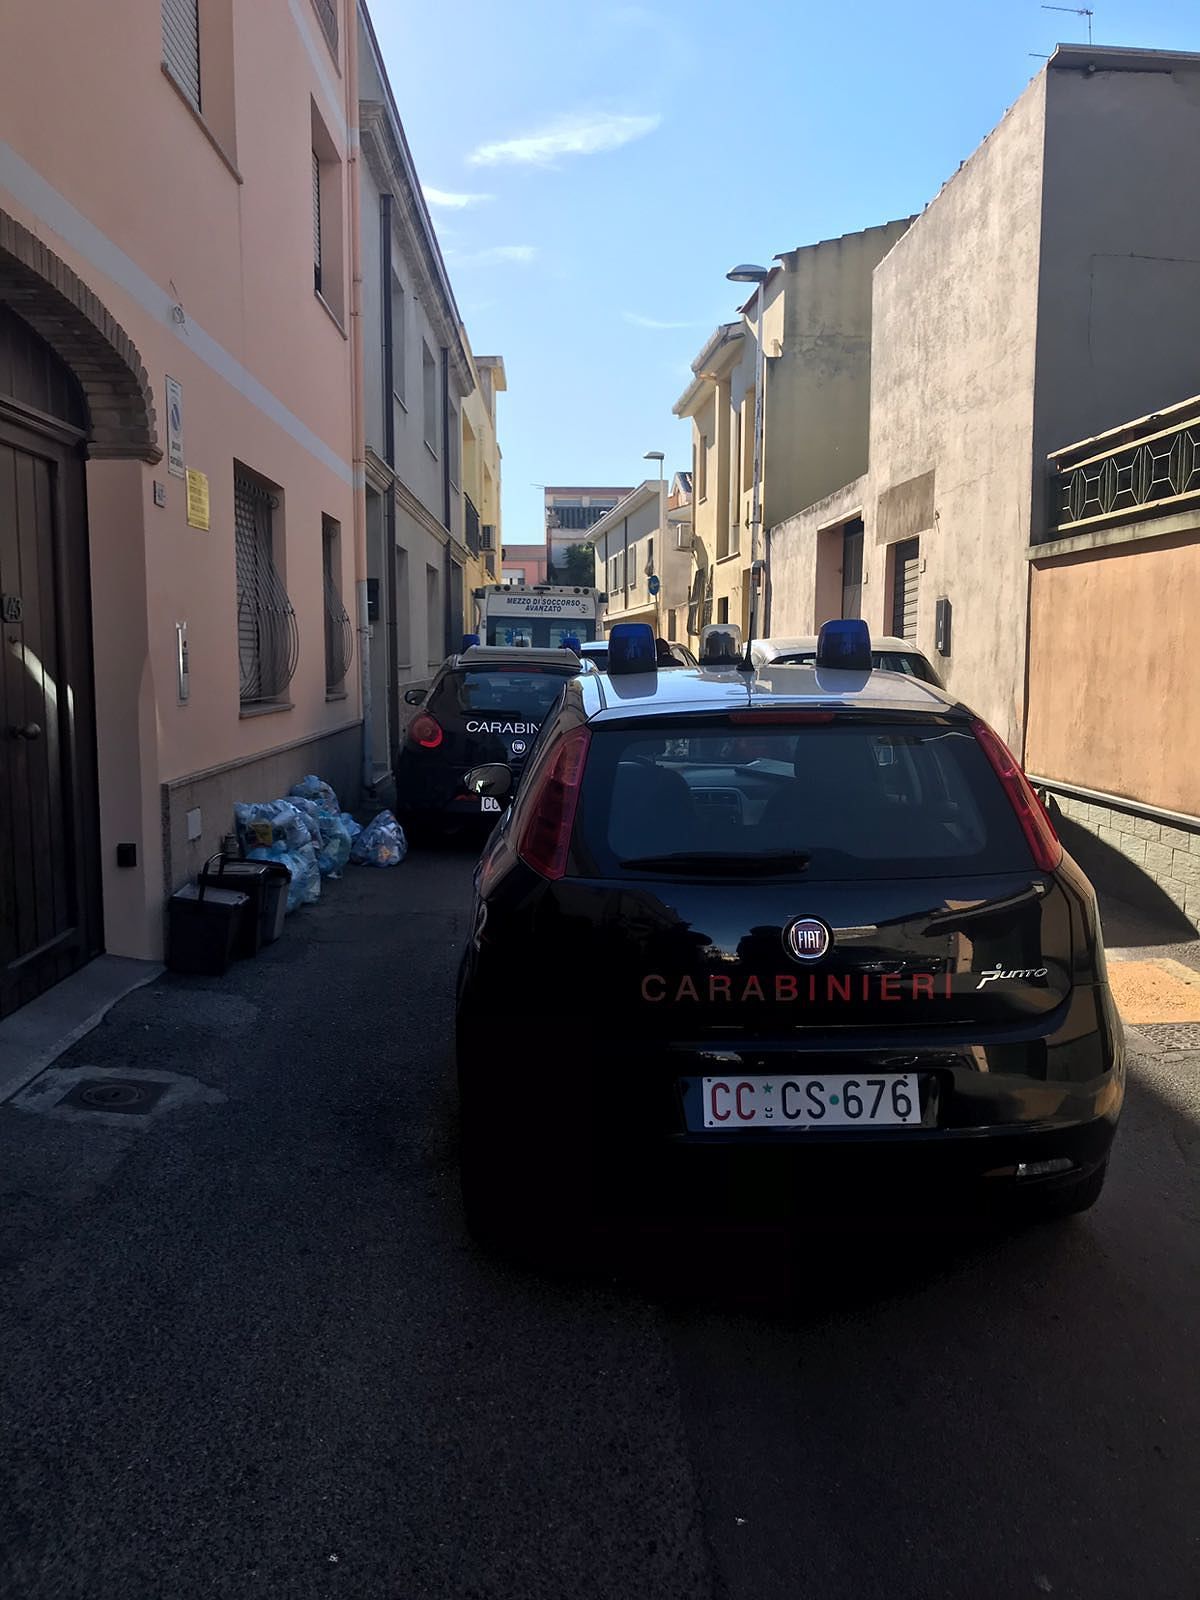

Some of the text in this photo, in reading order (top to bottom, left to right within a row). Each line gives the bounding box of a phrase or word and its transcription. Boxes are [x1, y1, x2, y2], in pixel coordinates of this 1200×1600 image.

[542, 599, 580, 607] SOCCORSO
[798, 927, 821, 949] FIAT
[641, 972, 953, 1003] CARABINIERI
[711, 1078, 913, 1121] CC CS 676
